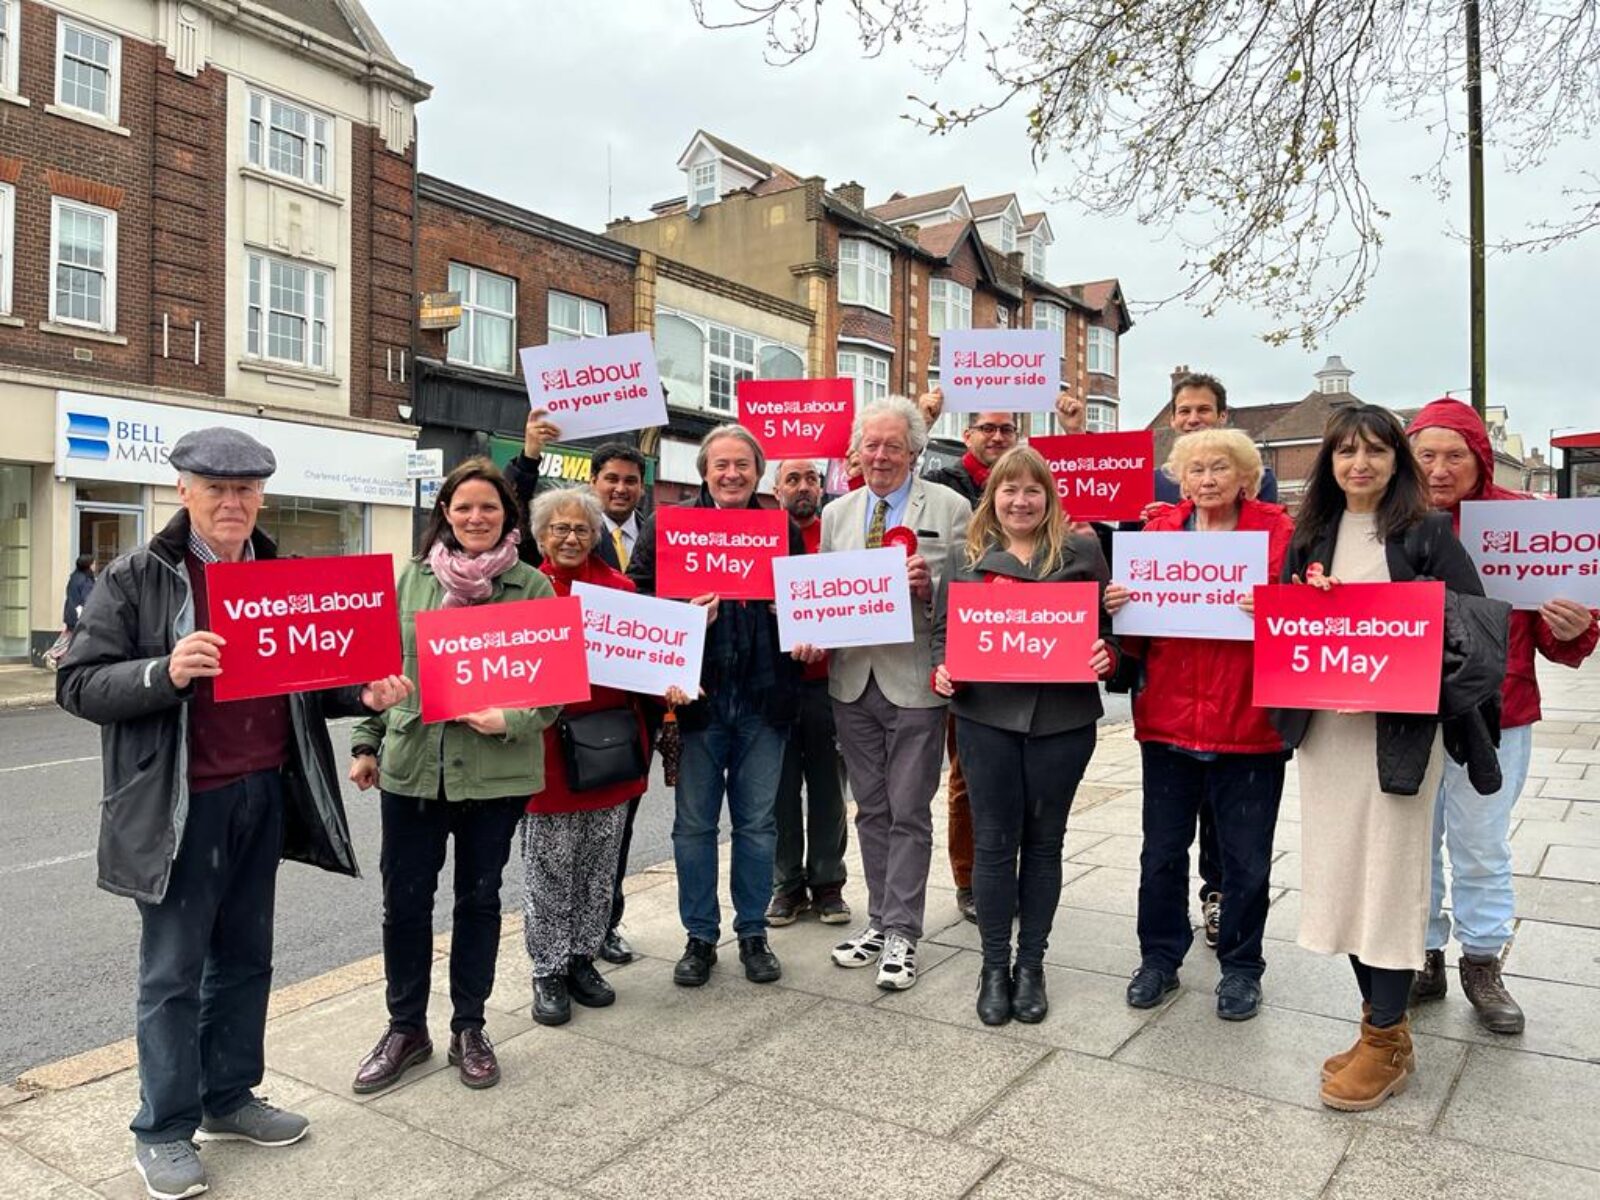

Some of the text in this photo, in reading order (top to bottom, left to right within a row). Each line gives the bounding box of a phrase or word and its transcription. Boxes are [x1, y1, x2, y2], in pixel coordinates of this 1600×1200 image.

[973, 351, 1045, 368] Labour
[563, 361, 642, 388] Labour
[954, 373, 1046, 388] on your side
[548, 384, 648, 412] on your side
[746, 400, 847, 415] Vote Labour
[116, 421, 164, 444] BELL
[764, 419, 825, 442] 5 May
[116, 444, 170, 465] MAIS
[1047, 456, 1145, 472] ote Labour
[538, 452, 592, 482] UBWA
[1057, 477, 1121, 502] 5 May
[666, 531, 780, 548] Vote Labour
[1512, 531, 1600, 553] Labo
[684, 552, 754, 578] 5 May
[1153, 560, 1248, 582] Labour
[1482, 559, 1600, 580] on your si
[811, 576, 893, 599] Labour
[1157, 591, 1201, 607] your
[223, 591, 384, 620] Vote Labour
[792, 599, 895, 624] on your side
[958, 608, 1088, 624] Vote Labour
[605, 613, 688, 647] Labour
[1267, 617, 1430, 637] Vote Labour
[257, 623, 354, 657] 5 May
[429, 626, 571, 655] Vote Labour
[977, 631, 1057, 658] 5 May
[605, 642, 646, 660] your
[649, 649, 686, 667] side
[1292, 645, 1388, 682] 5 May
[456, 656, 542, 684] 5 May
